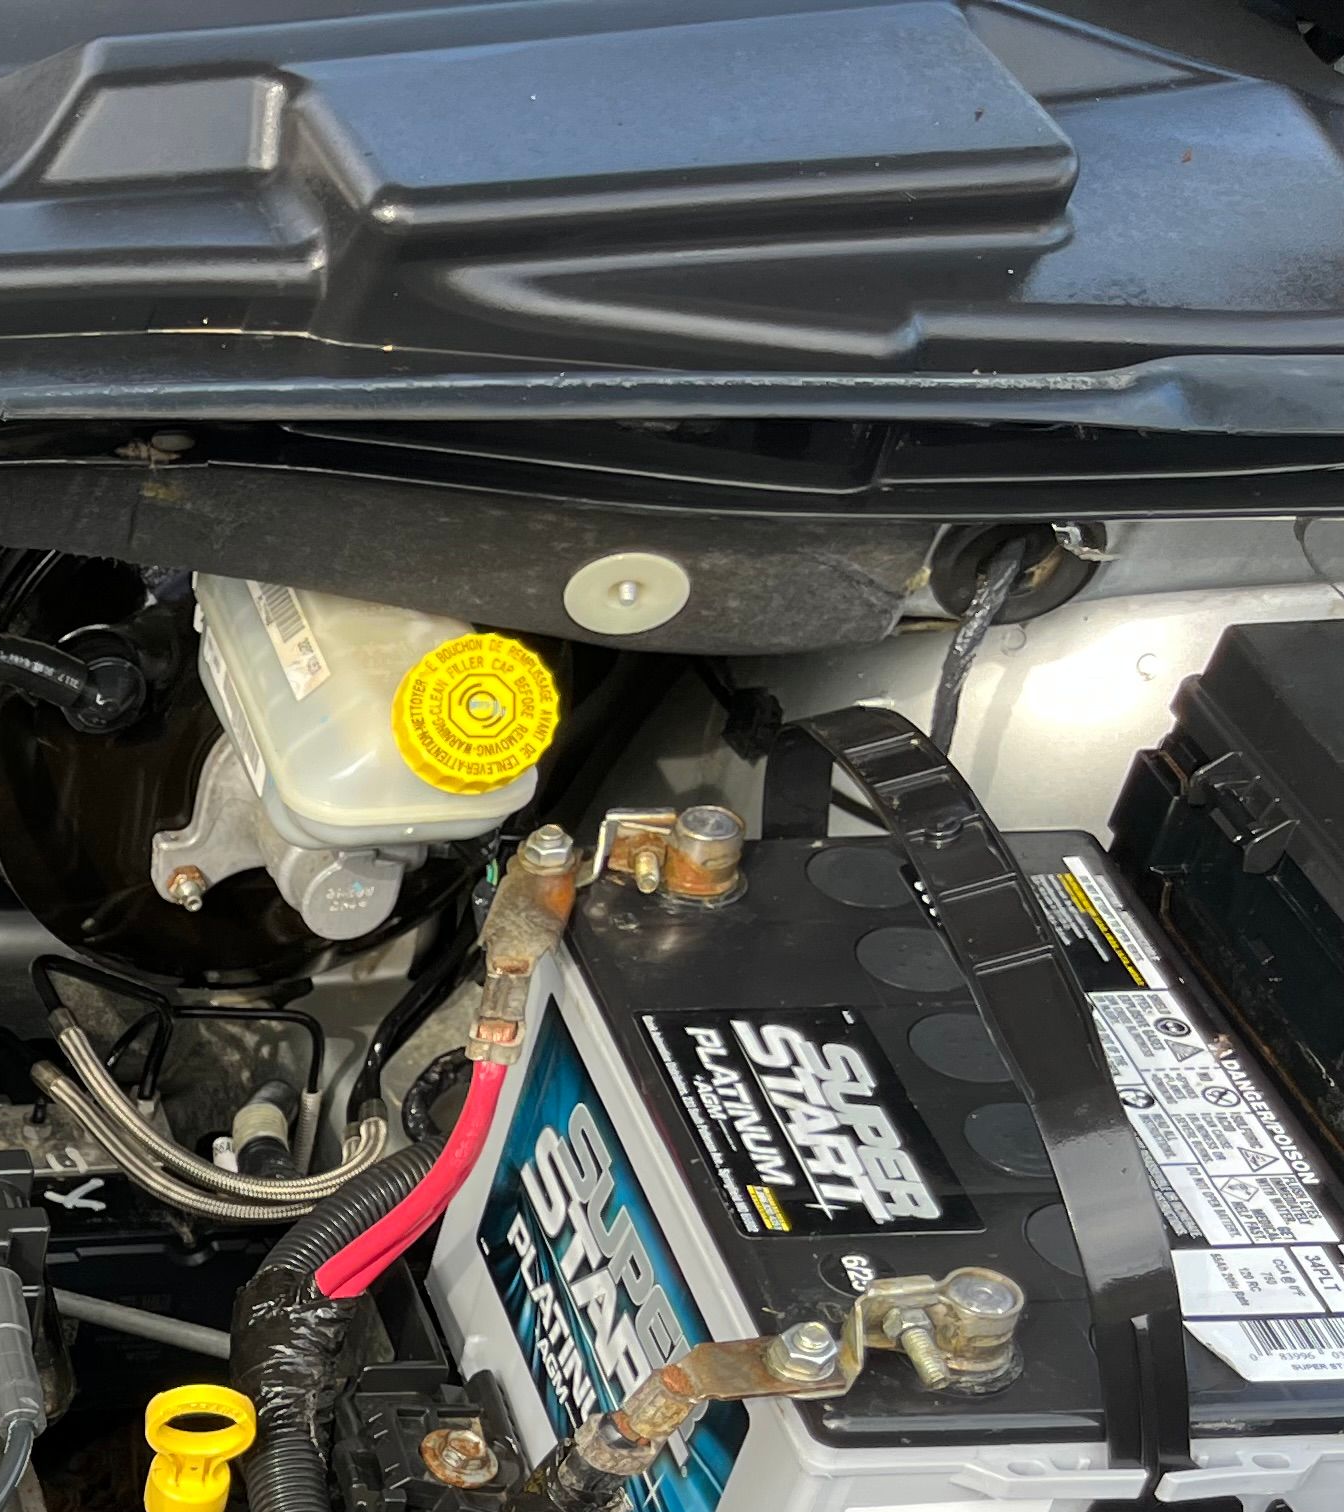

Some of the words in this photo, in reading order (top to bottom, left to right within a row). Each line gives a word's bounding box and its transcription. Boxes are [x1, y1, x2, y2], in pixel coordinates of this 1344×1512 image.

[436, 639, 482, 664] BOUCHON
[489, 639, 503, 652] DE
[446, 656, 484, 679] FILLER
[491, 658, 514, 674] CAP
[514, 676, 535, 719] BEFORE
[510, 645, 553, 703] REMPLISSAGE
[533, 709, 553, 743] AVANT
[519, 743, 537, 759] DE
[685, 1026, 796, 1186] PLATINUM
[695, 1080, 726, 1120] AGM
[730, 1020, 897, 1225] START
[821, 1043, 942, 1220] SUPER
[1221, 1059, 1319, 1186] DANGER/POISON
[1300, 1201, 1322, 1219] EYES
[1272, 1258, 1290, 1275] CCA
[1305, 1255, 1341, 1292] 34PLT
[536, 1338, 569, 1407] AGM
